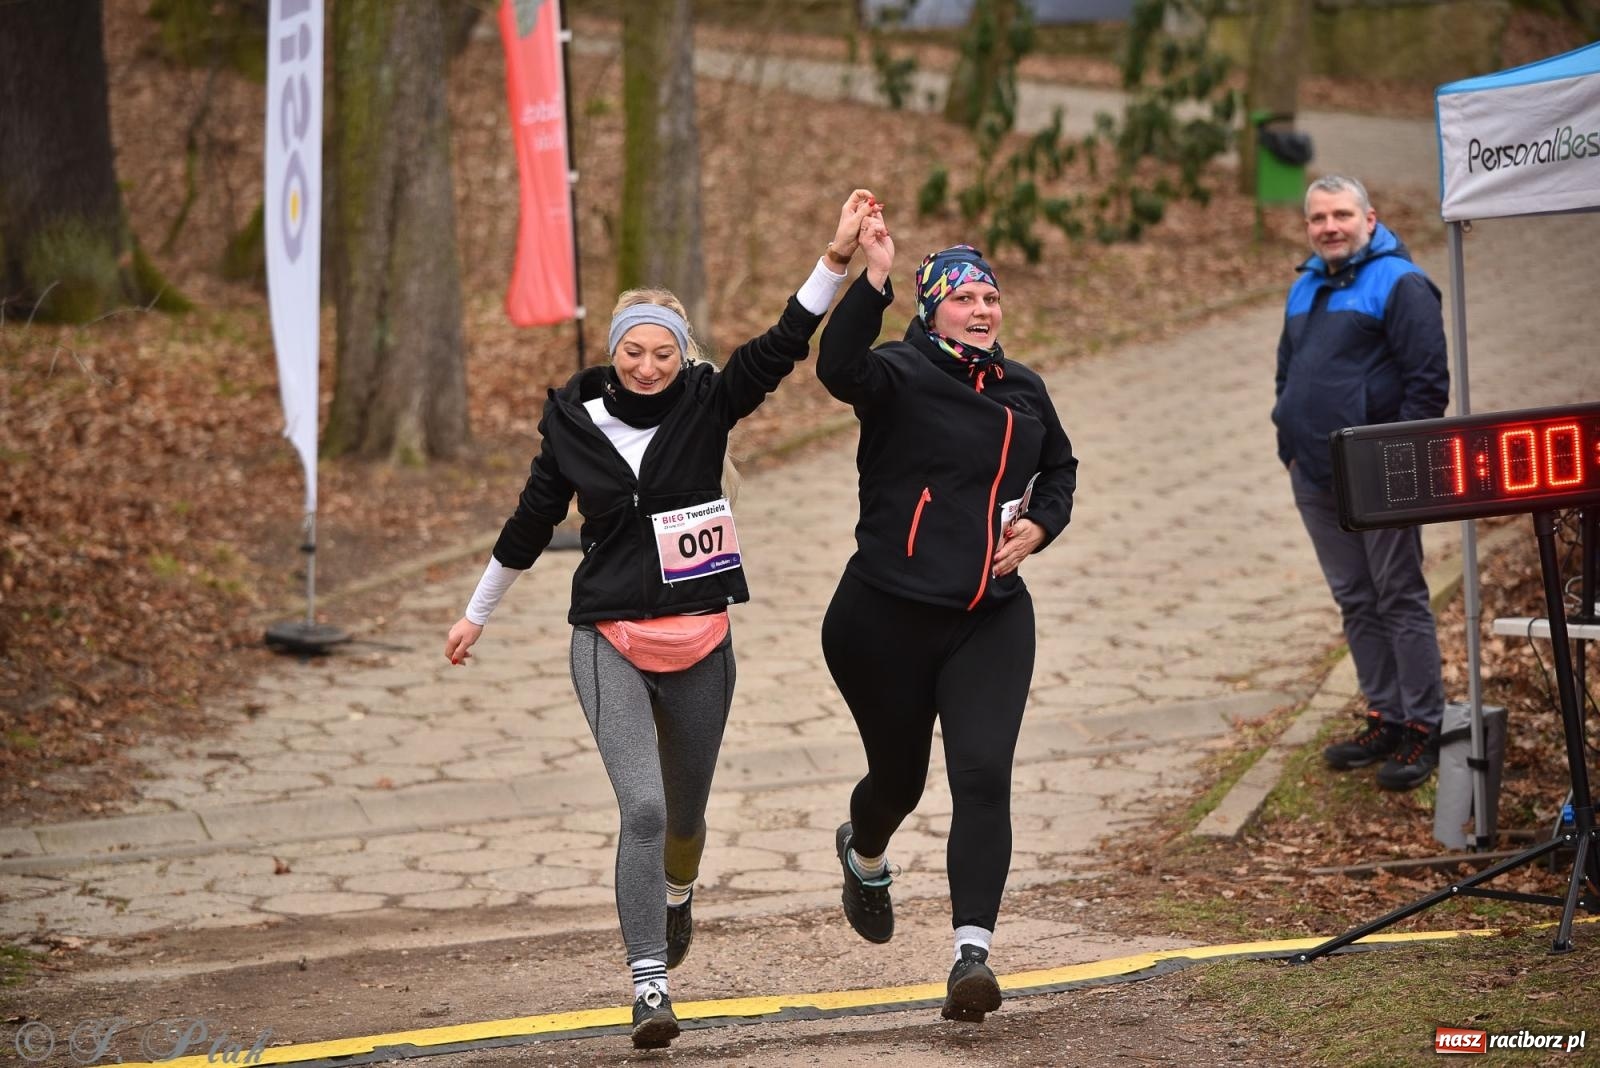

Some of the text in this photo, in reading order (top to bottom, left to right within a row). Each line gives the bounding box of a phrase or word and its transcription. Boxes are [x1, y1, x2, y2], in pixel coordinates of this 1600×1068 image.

[1468, 126, 1600, 173] PersonalBes
[662, 503, 726, 525] BIEG Twardziela
[678, 525, 723, 558] 007
